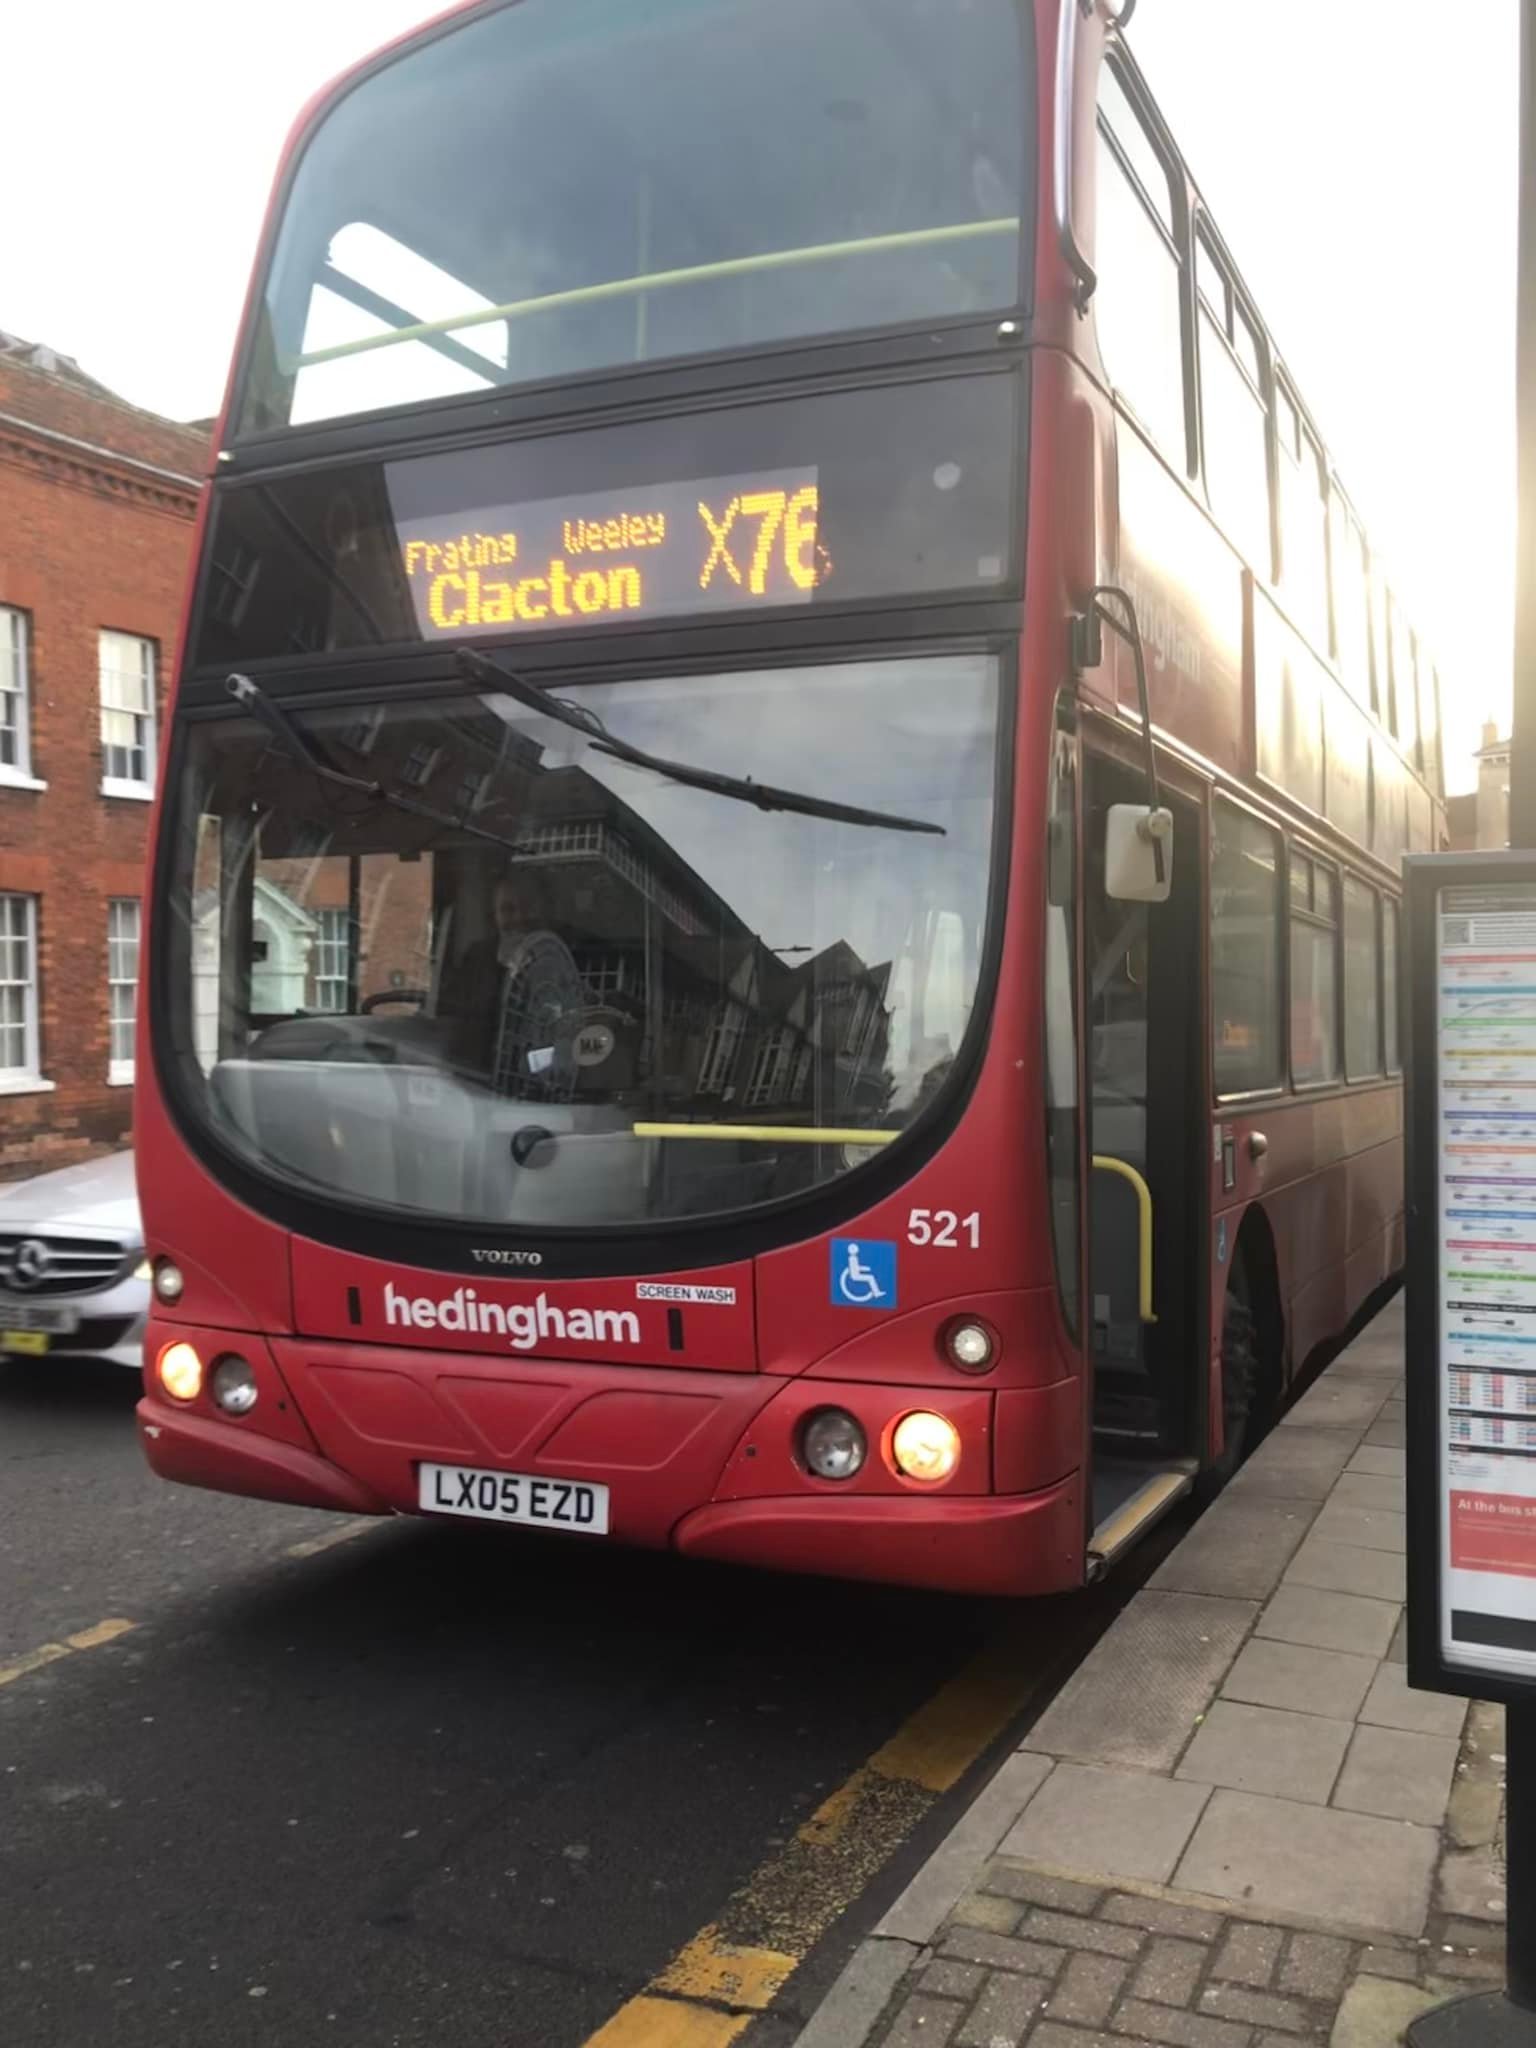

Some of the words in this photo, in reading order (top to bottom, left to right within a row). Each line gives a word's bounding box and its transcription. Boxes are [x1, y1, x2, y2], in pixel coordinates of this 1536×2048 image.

[563, 512, 665, 555] Weeley
[698, 486, 833, 594] X76
[428, 559, 641, 628] Clacton
[907, 1208, 980, 1249] 521
[472, 1249, 543, 1266] VOLVO
[383, 1280, 641, 1350] hedingham
[638, 1284, 691, 1300] SCREEN
[695, 1287, 733, 1302] WASH
[435, 1469, 520, 1514] LX05
[529, 1481, 595, 1524] EZD
